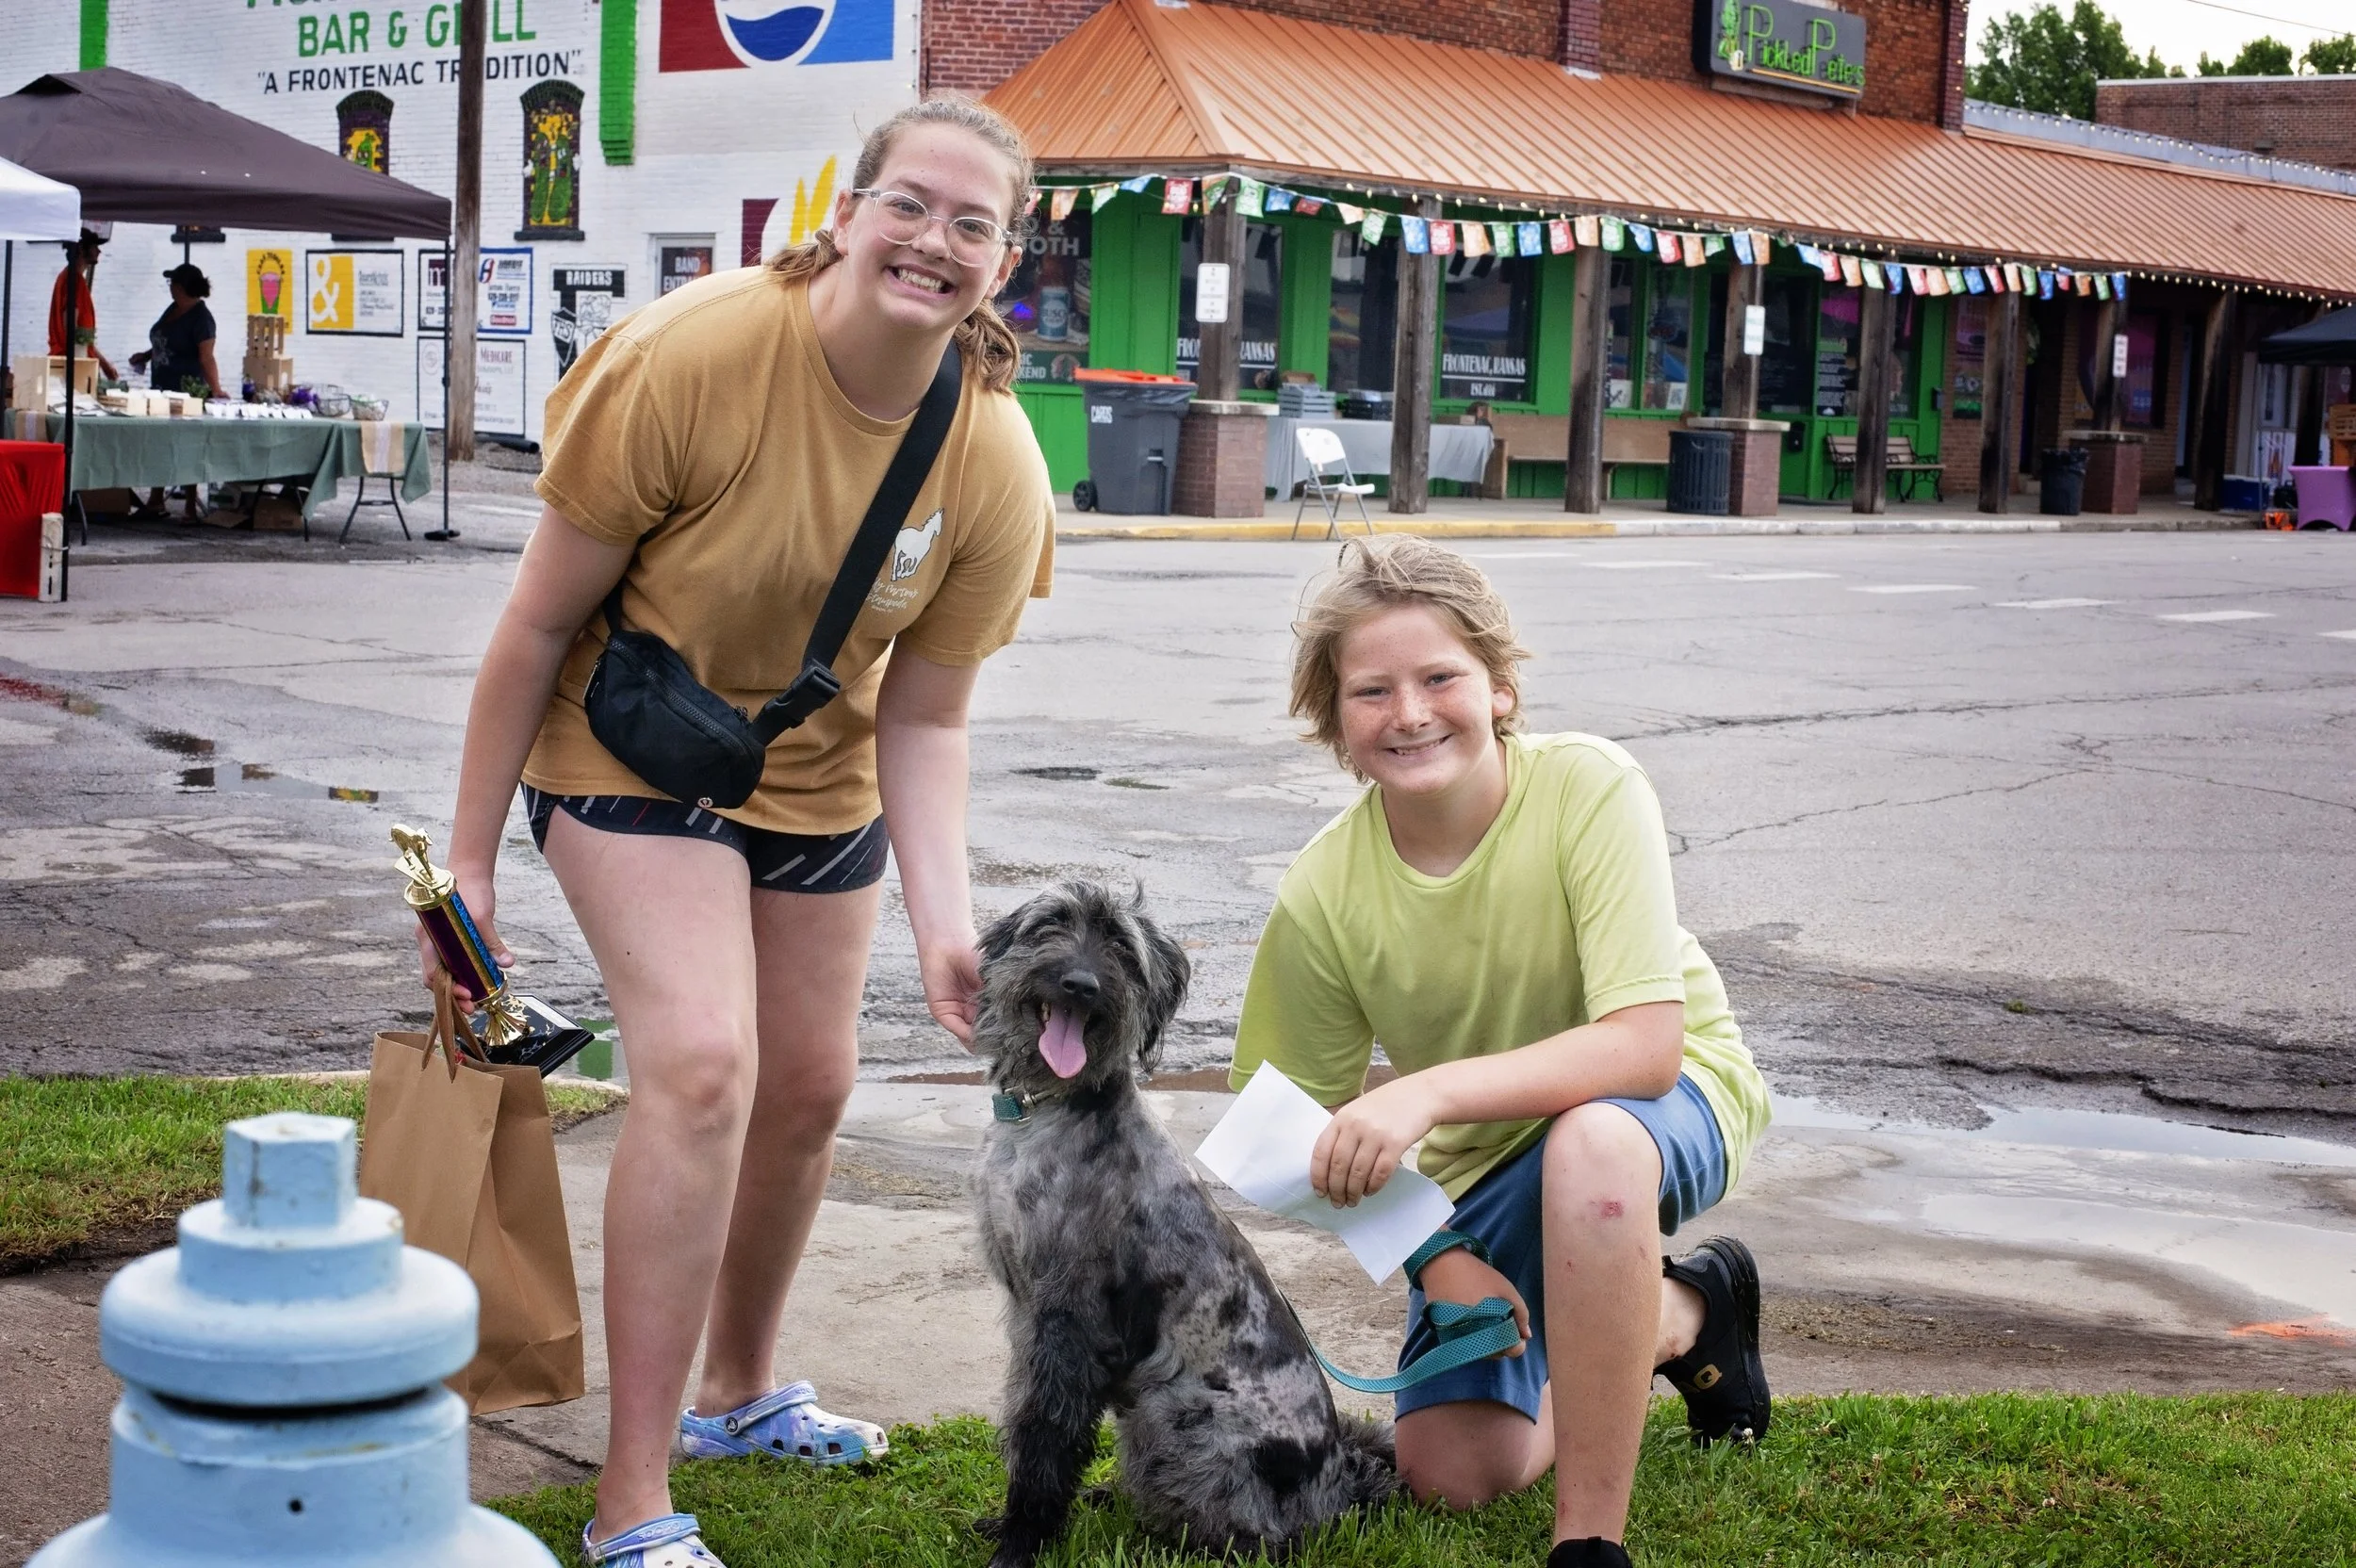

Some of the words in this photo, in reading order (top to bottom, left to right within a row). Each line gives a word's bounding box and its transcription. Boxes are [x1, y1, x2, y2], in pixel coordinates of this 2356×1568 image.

[298, 10, 371, 57] BAR
[388, 10, 408, 48] &
[426, 0, 537, 48] GLL
[287, 61, 425, 92] FRONTENAC
[435, 50, 581, 83] TRDITION"
[565, 270, 613, 286] RAIDERS
[675, 256, 701, 273] BAND
